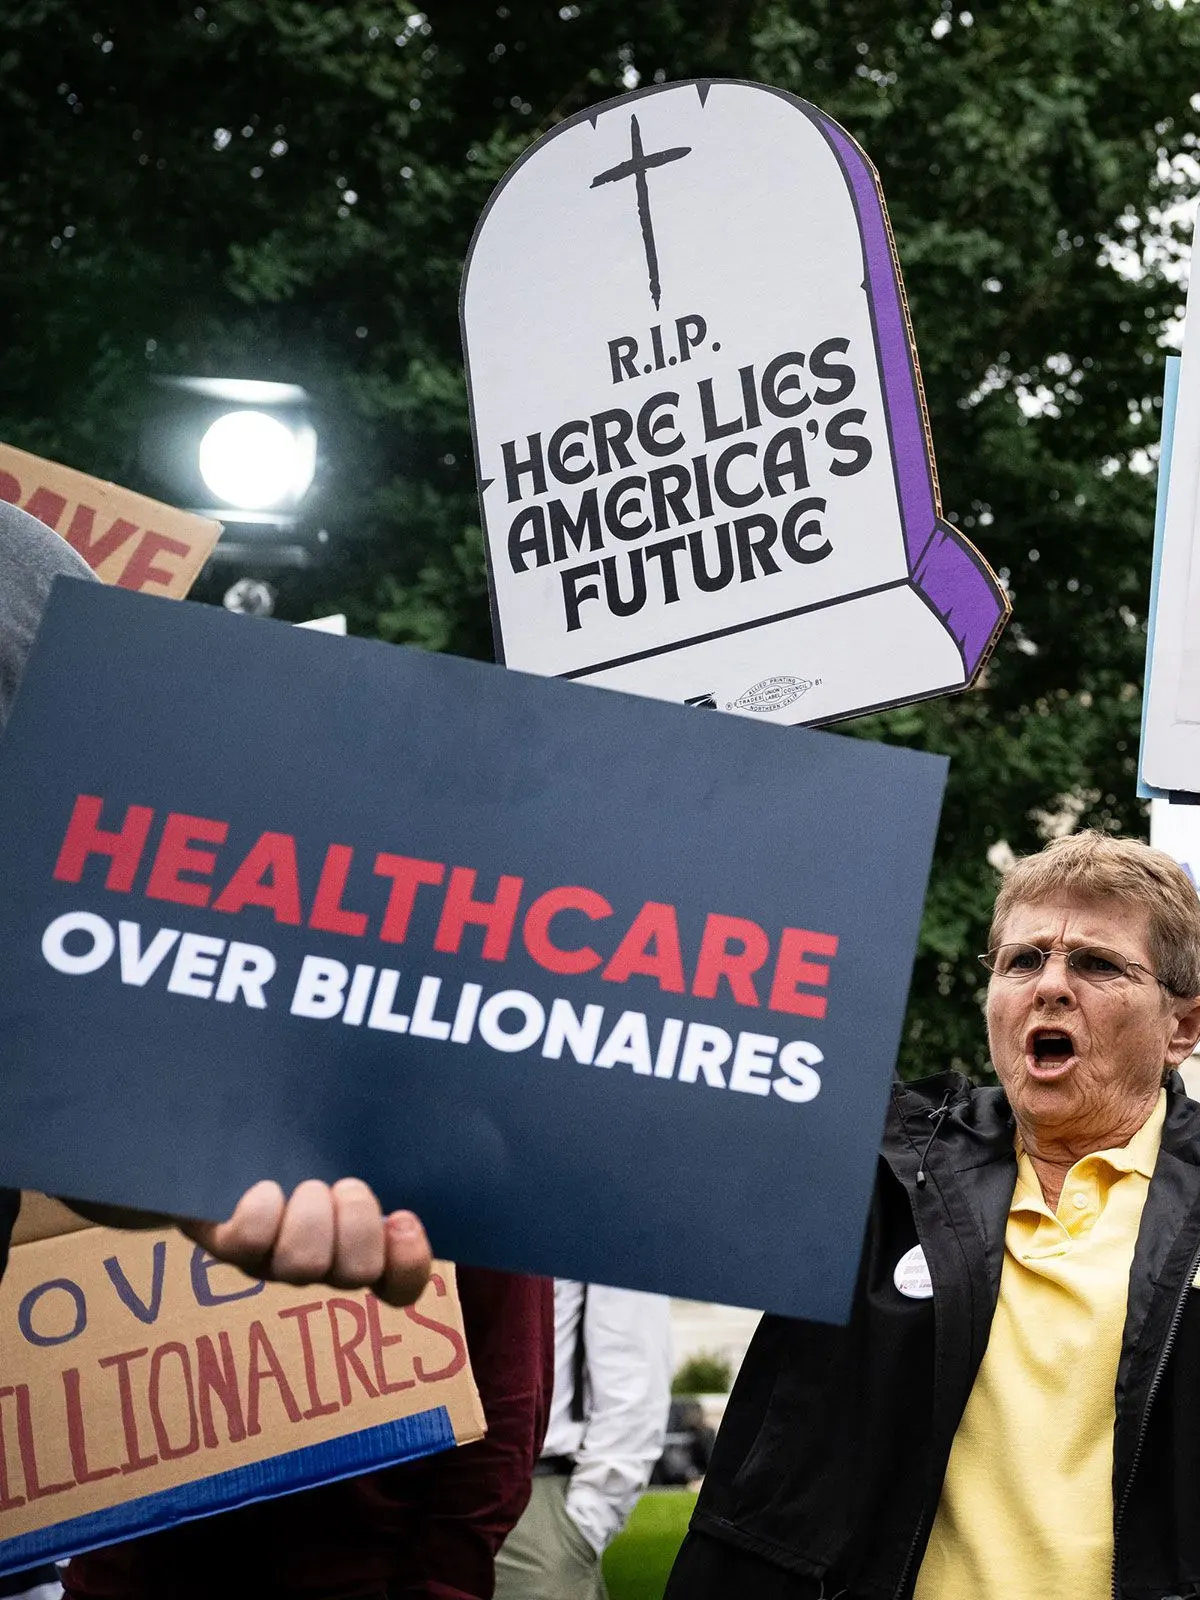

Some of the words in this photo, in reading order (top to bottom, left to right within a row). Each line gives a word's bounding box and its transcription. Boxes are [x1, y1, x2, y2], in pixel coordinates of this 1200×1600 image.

[607, 314, 721, 384] R.I.P.
[500, 391, 686, 503] HERE
[697, 337, 856, 443] LIES
[507, 408, 873, 574] AMERICA'S
[560, 496, 834, 633] FUTURE
[739, 694, 762, 706] TRADES
[783, 683, 808, 694] COUNCIL
[748, 681, 767, 695] ALLIED
[769, 677, 796, 685] PRINTING
[750, 704, 781, 712] NORTHERN
[764, 687, 780, 696] UNION
[765, 693, 781, 702] LABEL
[52, 793, 841, 1020] HEALTHCARE
[41, 910, 277, 1009] OVER
[290, 954, 825, 1104] BILLIONAIRES
[18, 1241, 266, 1347] OVE
